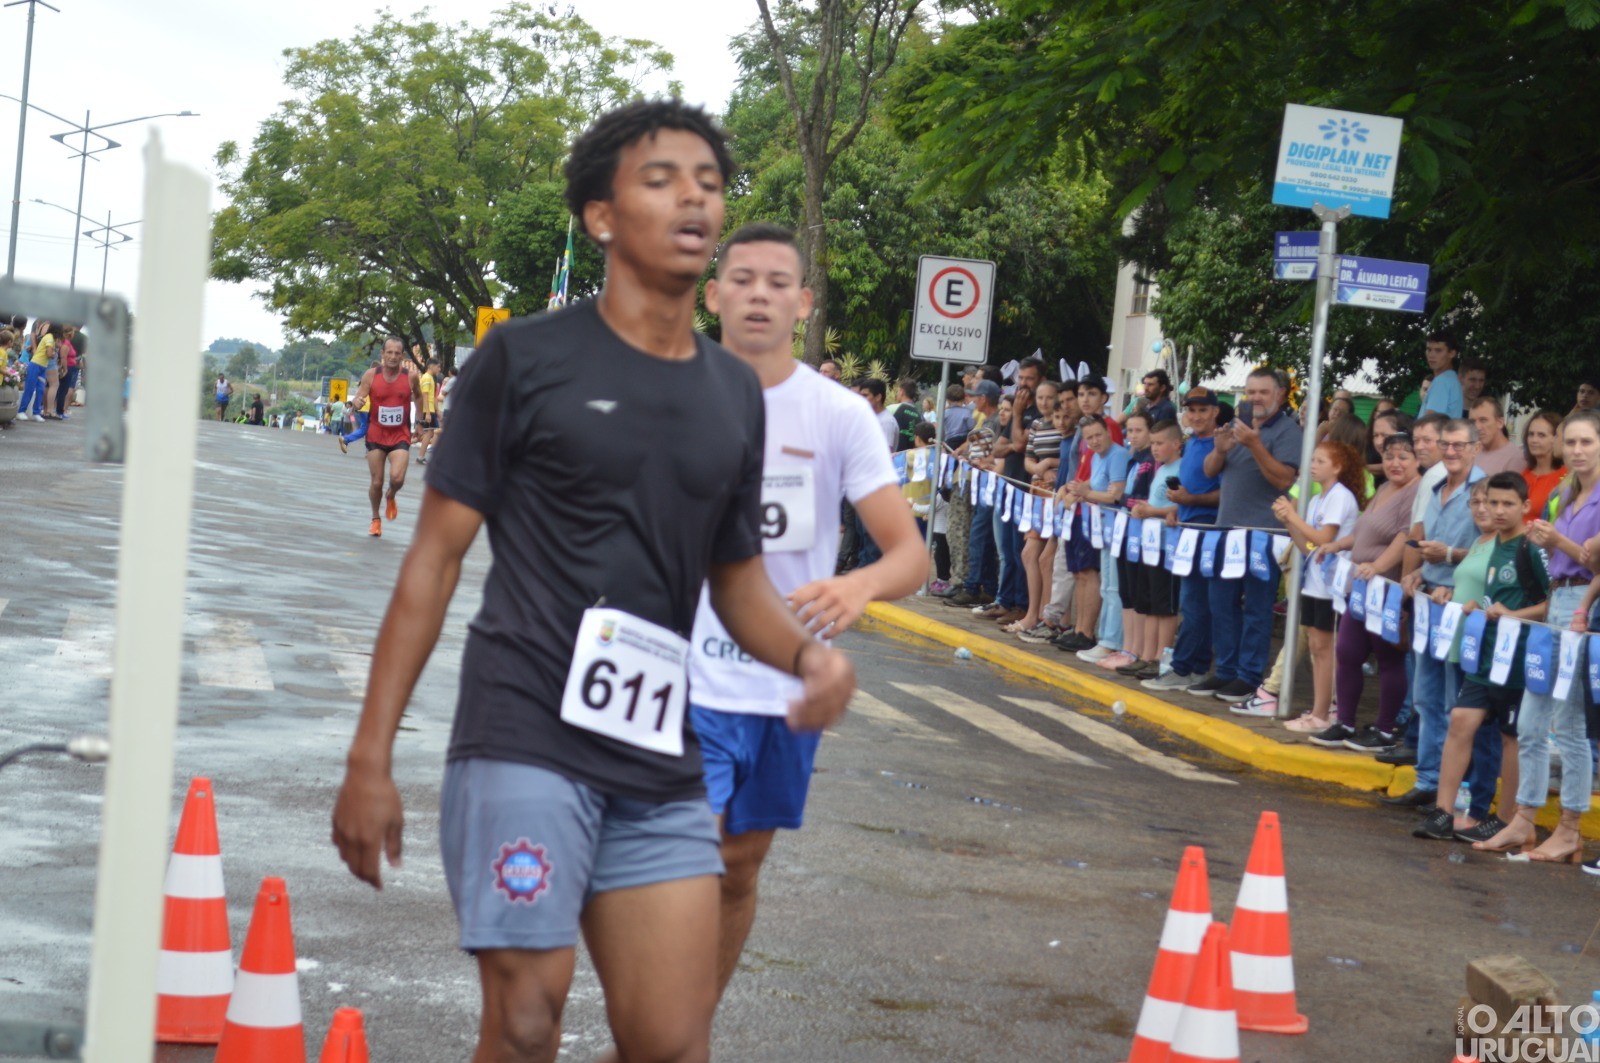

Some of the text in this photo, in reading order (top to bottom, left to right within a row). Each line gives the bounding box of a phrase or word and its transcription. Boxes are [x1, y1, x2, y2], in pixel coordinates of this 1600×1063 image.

[1288, 142, 1392, 170] DIGIPLAN NET
[1285, 158, 1321, 169] PROVEDOR
[1354, 168, 1386, 178] INTERNET
[1342, 259, 1358, 268] RUA
[1340, 268, 1419, 289] DR. ÁLVARO LEITÃO
[945, 279, 963, 306] E
[919, 323, 982, 339] EXCLUSIVO
[938, 337, 962, 352] TÁXI
[381, 413, 402, 423] 518
[760, 501, 788, 539] 9
[702, 637, 753, 663] CRE
[580, 657, 673, 732] 611
